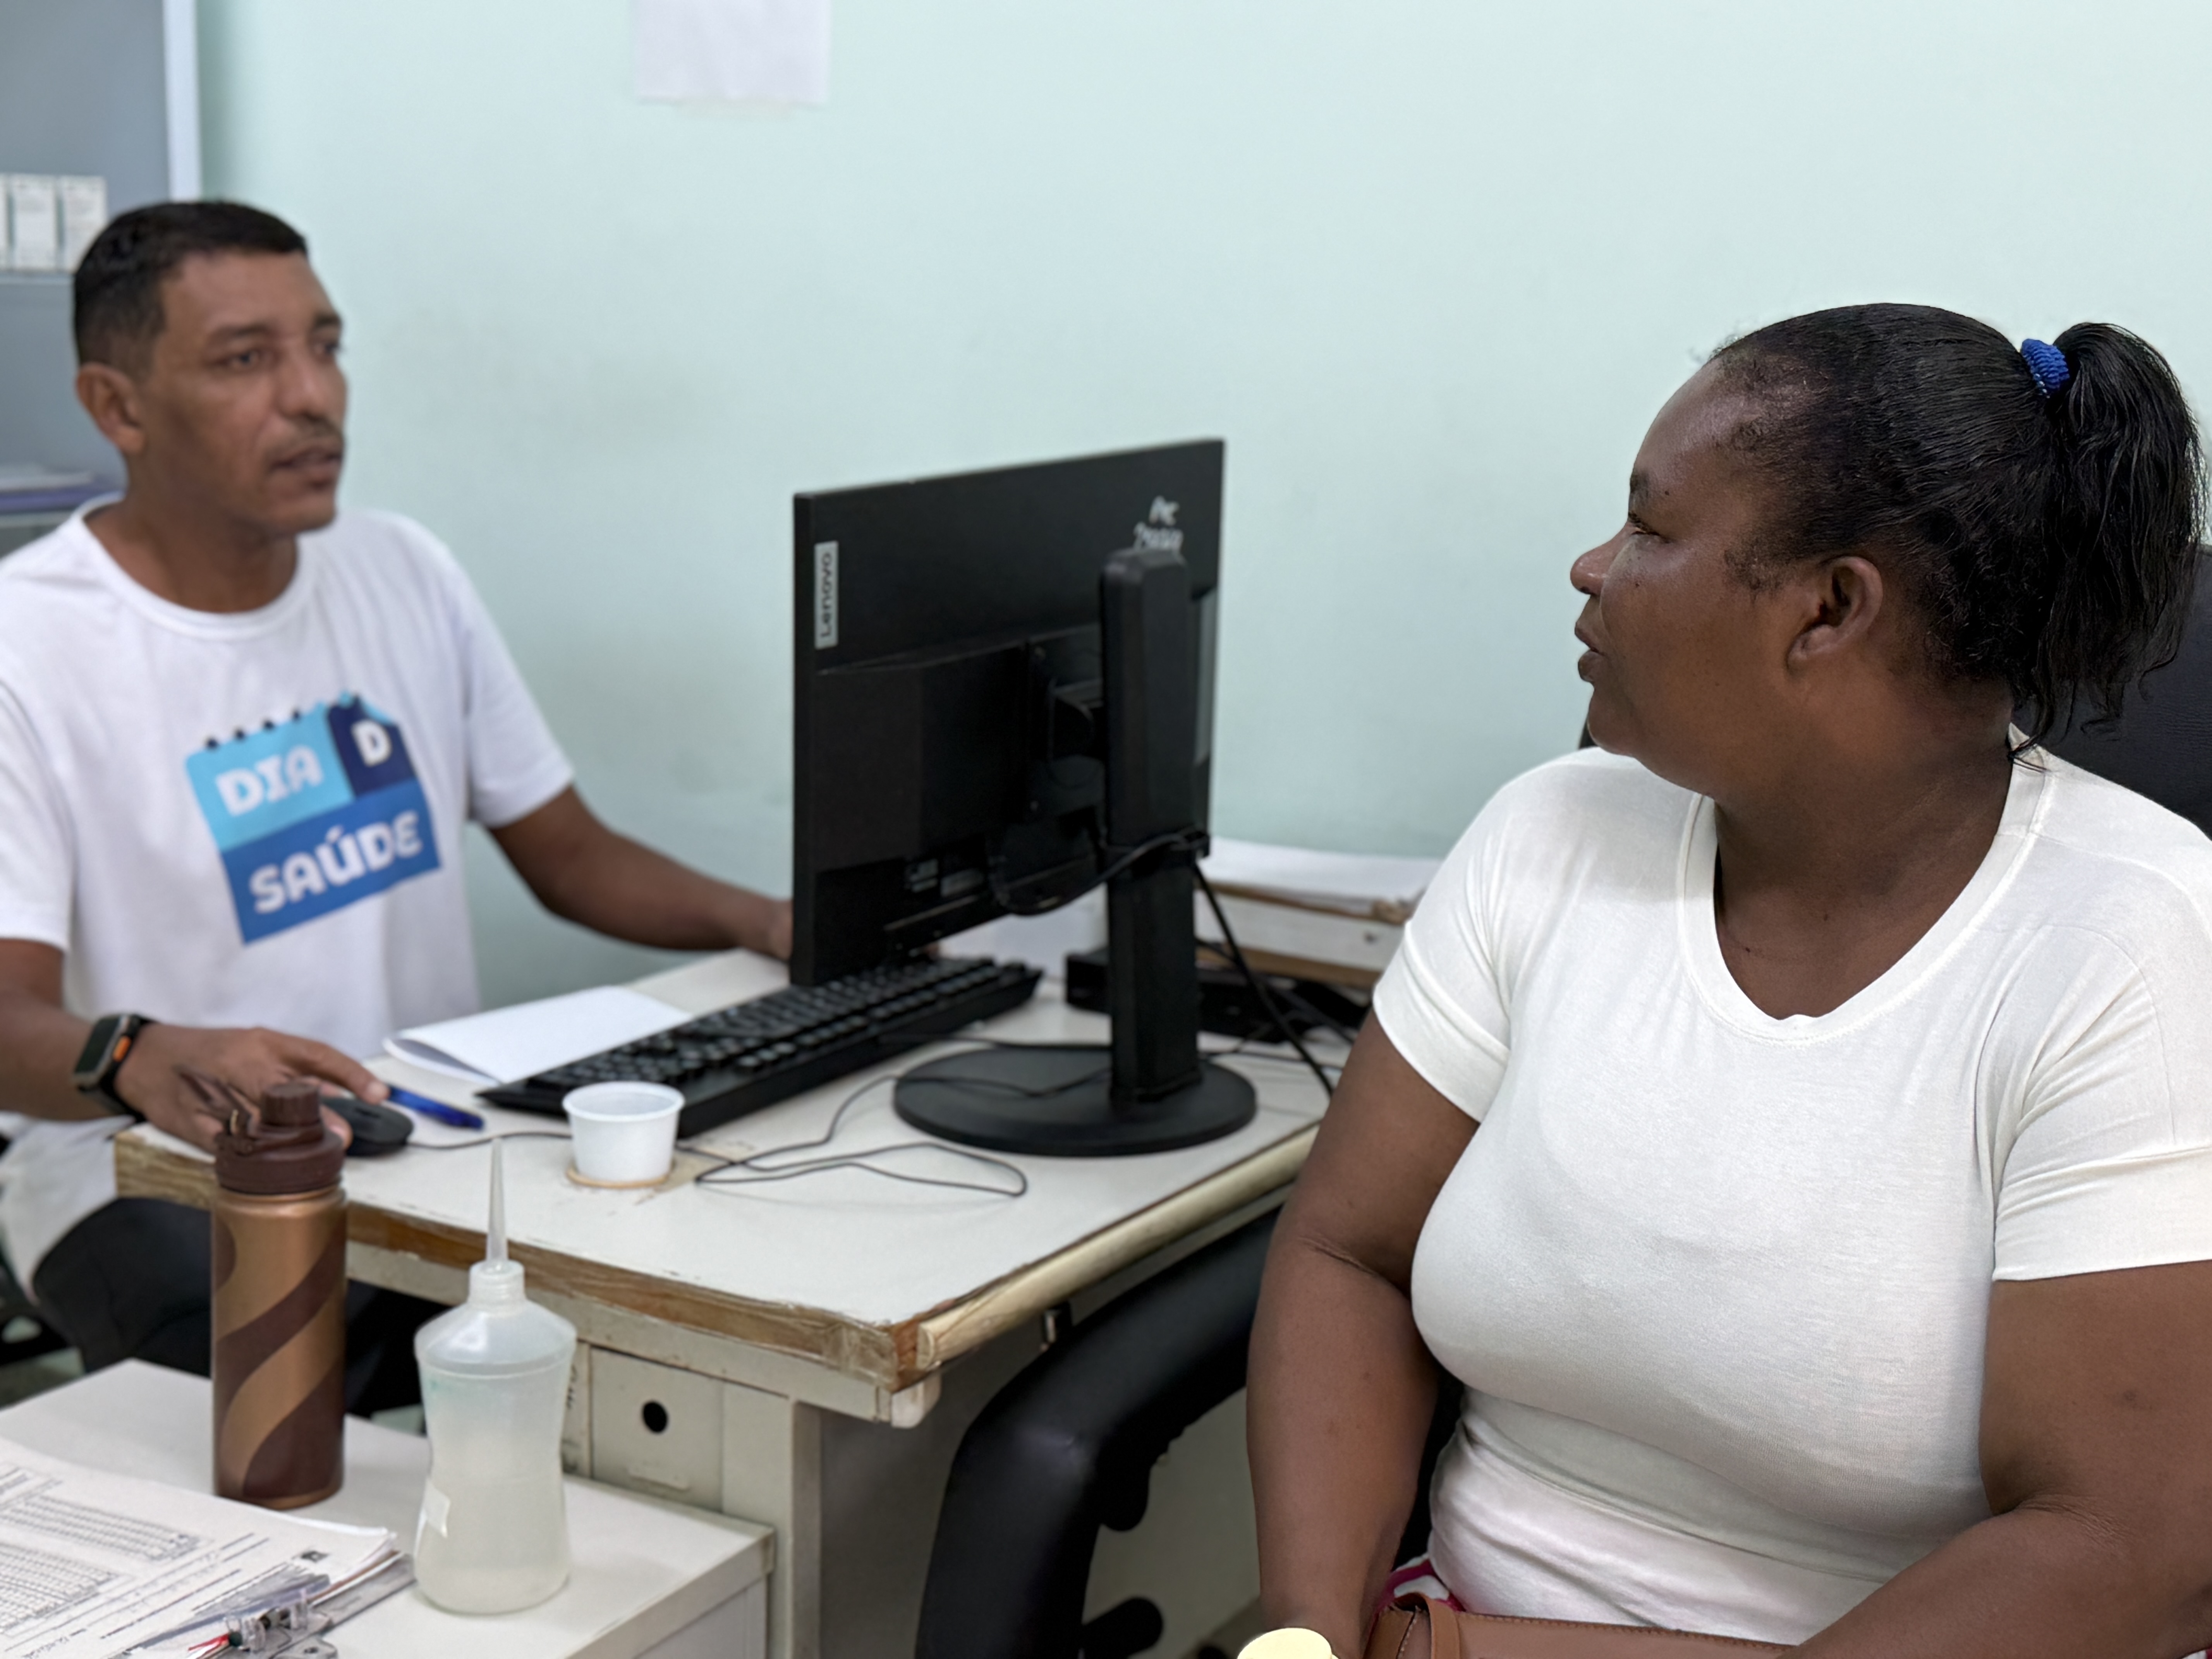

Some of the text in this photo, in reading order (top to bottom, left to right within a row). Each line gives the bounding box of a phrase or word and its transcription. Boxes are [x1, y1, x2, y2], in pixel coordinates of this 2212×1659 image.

[820, 552, 833, 637] Lenovo
[215, 719, 391, 816] DIA D
[249, 810, 422, 913] SAÚDE
